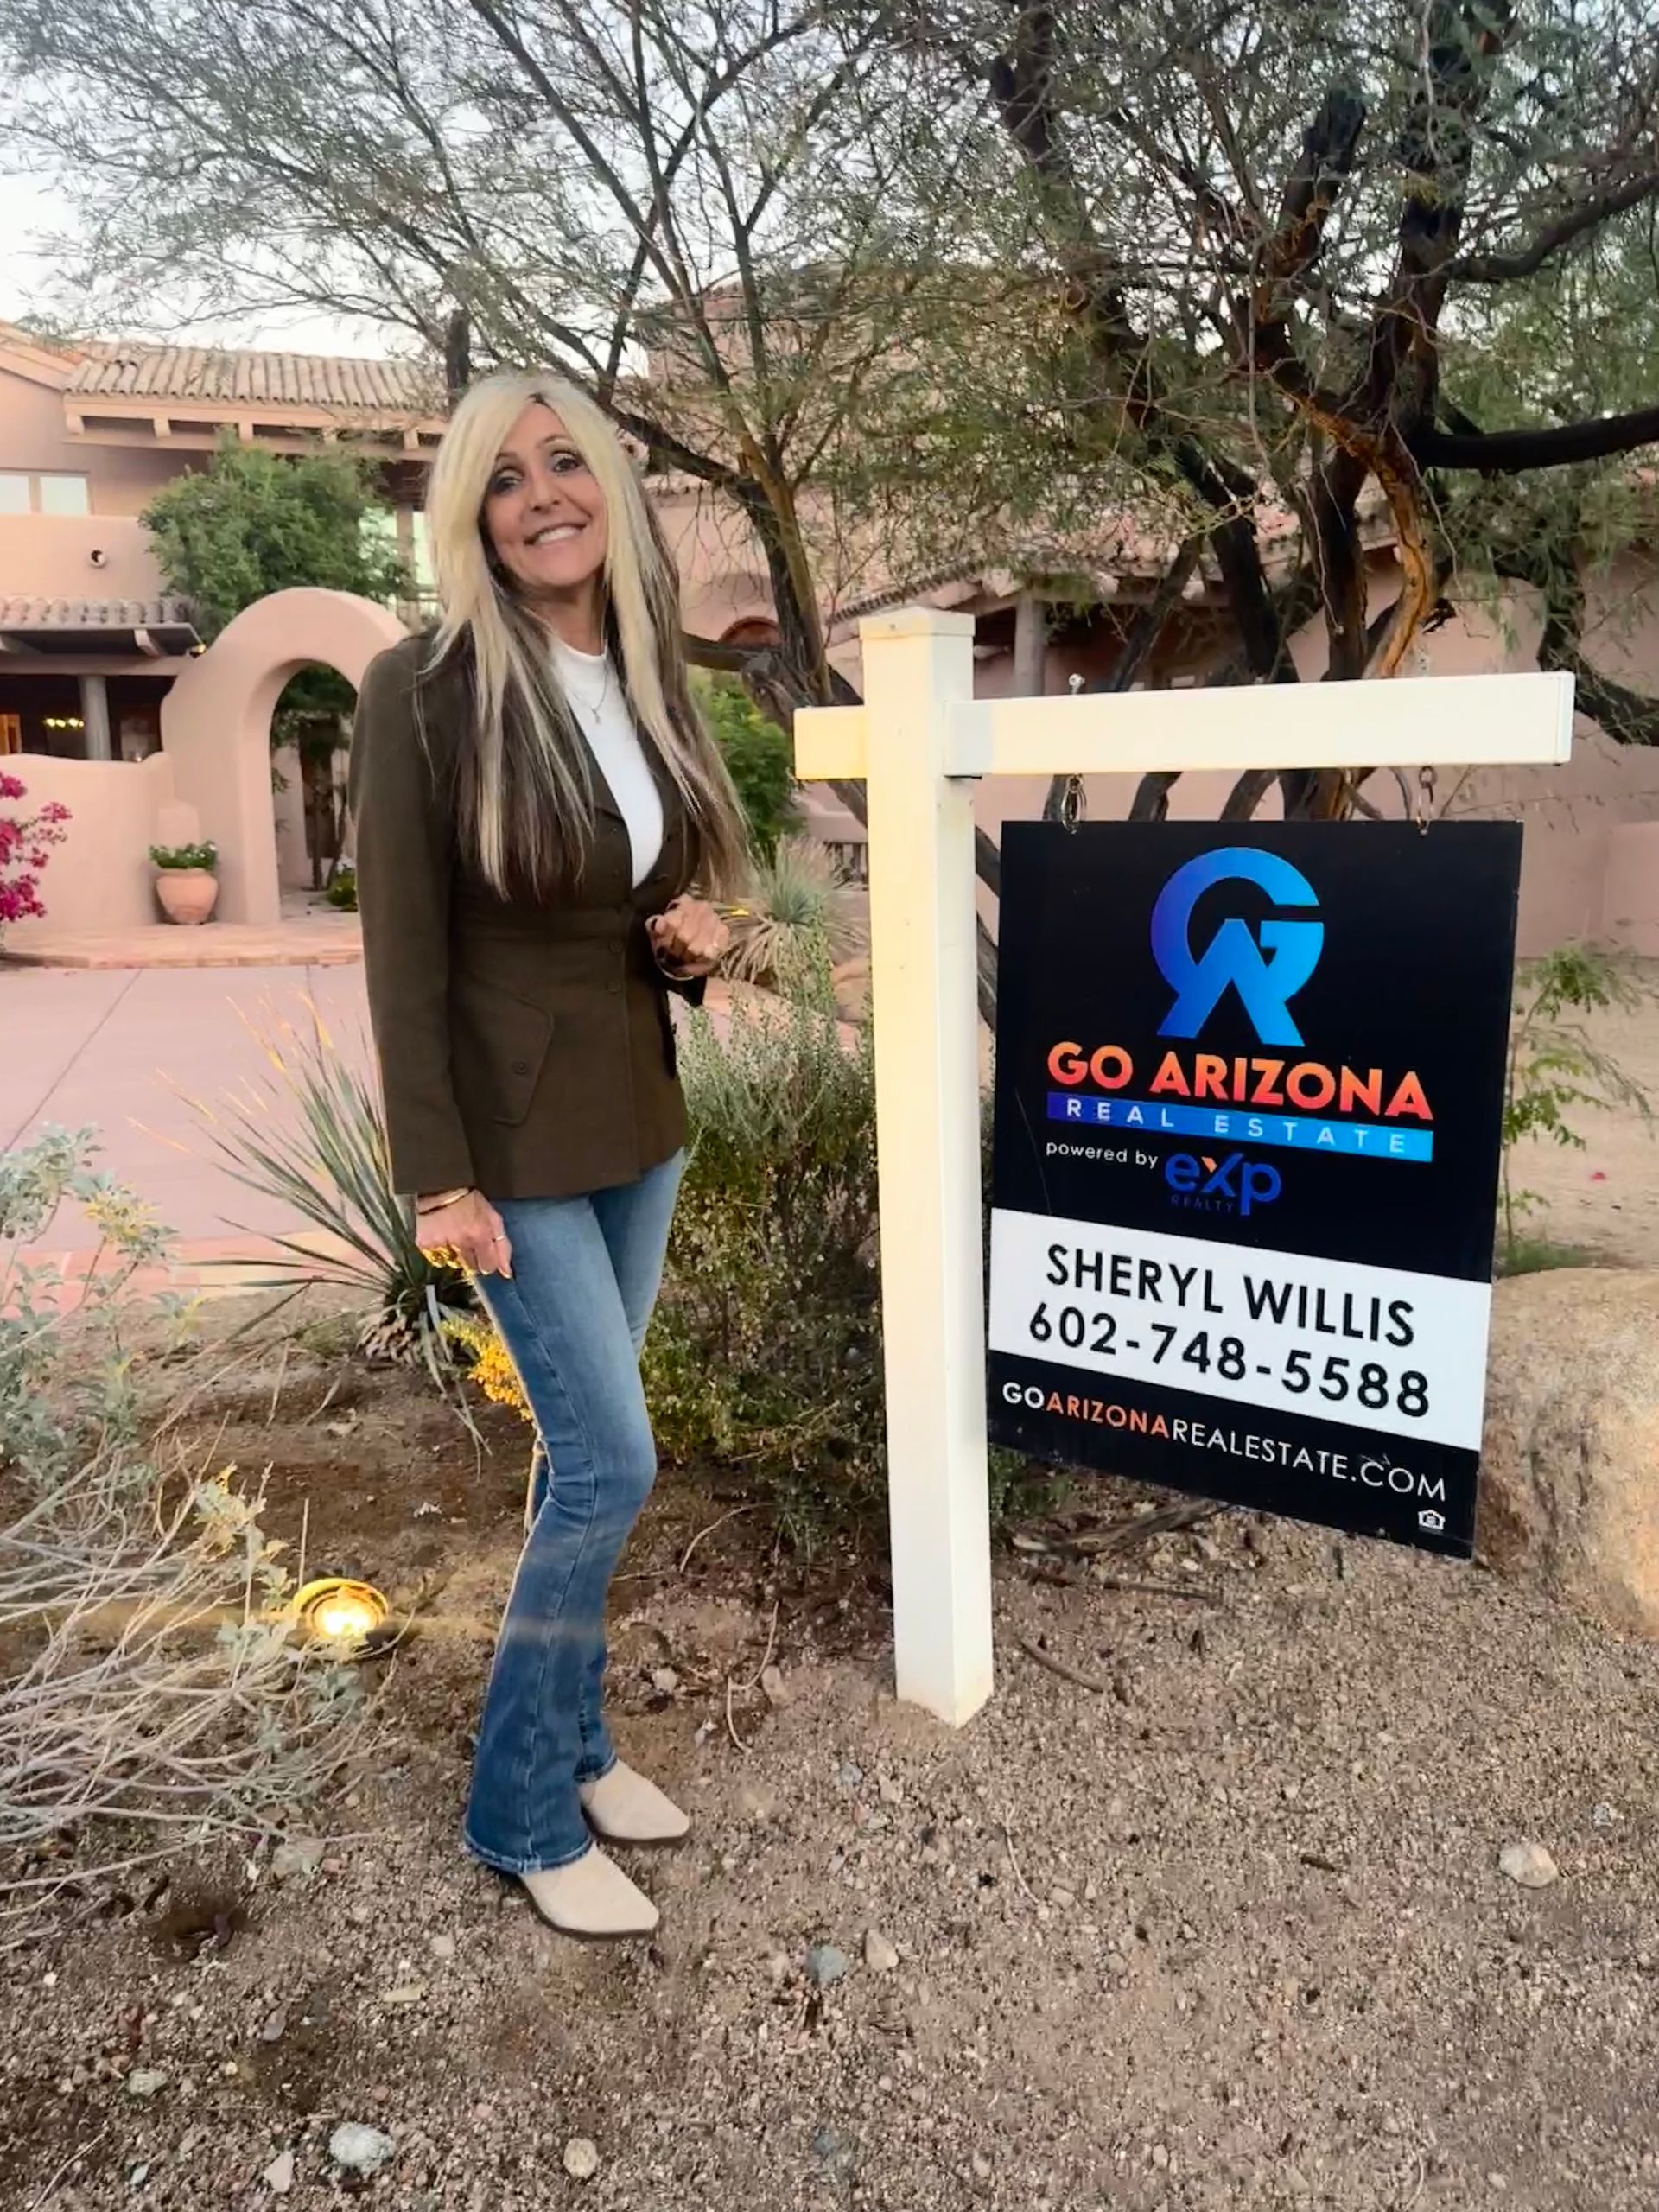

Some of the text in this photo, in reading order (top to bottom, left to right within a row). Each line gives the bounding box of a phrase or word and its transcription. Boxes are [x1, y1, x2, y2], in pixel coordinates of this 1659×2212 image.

[1047, 1041, 1433, 1121] GO ARIZONA
[1046, 1141, 1158, 1170] powered by
[1066, 1099, 1406, 1153] REAL ESTATE
[1171, 1195, 1234, 1214] REALTY
[1046, 1243, 1415, 1347] SHERYL WILLIS
[1029, 1302, 1430, 1418] 602-748-5588
[1002, 1382, 1446, 1502] GOARIZONAREALESTATE.COM
